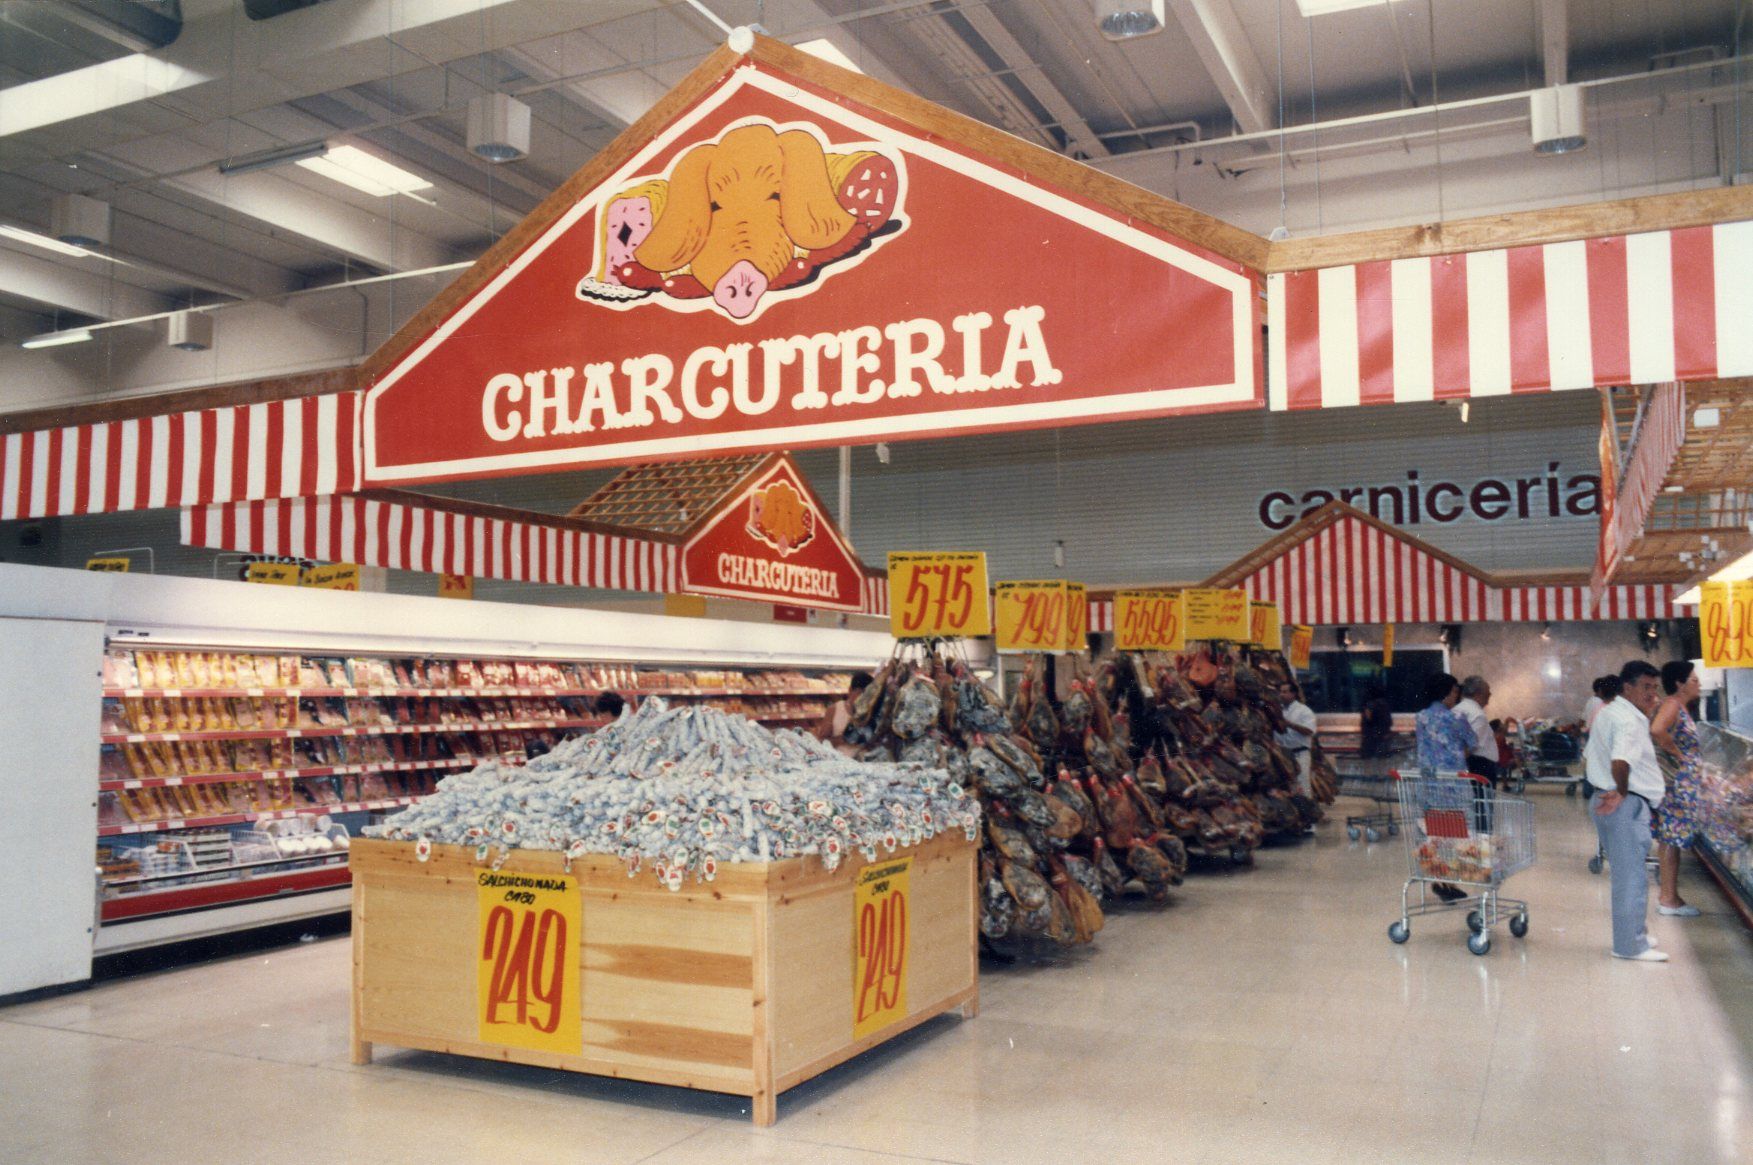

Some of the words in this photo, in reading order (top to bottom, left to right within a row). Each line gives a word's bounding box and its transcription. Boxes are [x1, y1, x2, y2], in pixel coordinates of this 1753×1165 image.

[482, 305, 1063, 442] CHARCUTERIA
[717, 553, 840, 599] CHARCUTERIA
[903, 565, 974, 632] 575
[1011, 591, 1064, 646] 799
[1123, 598, 1177, 646] 5595
